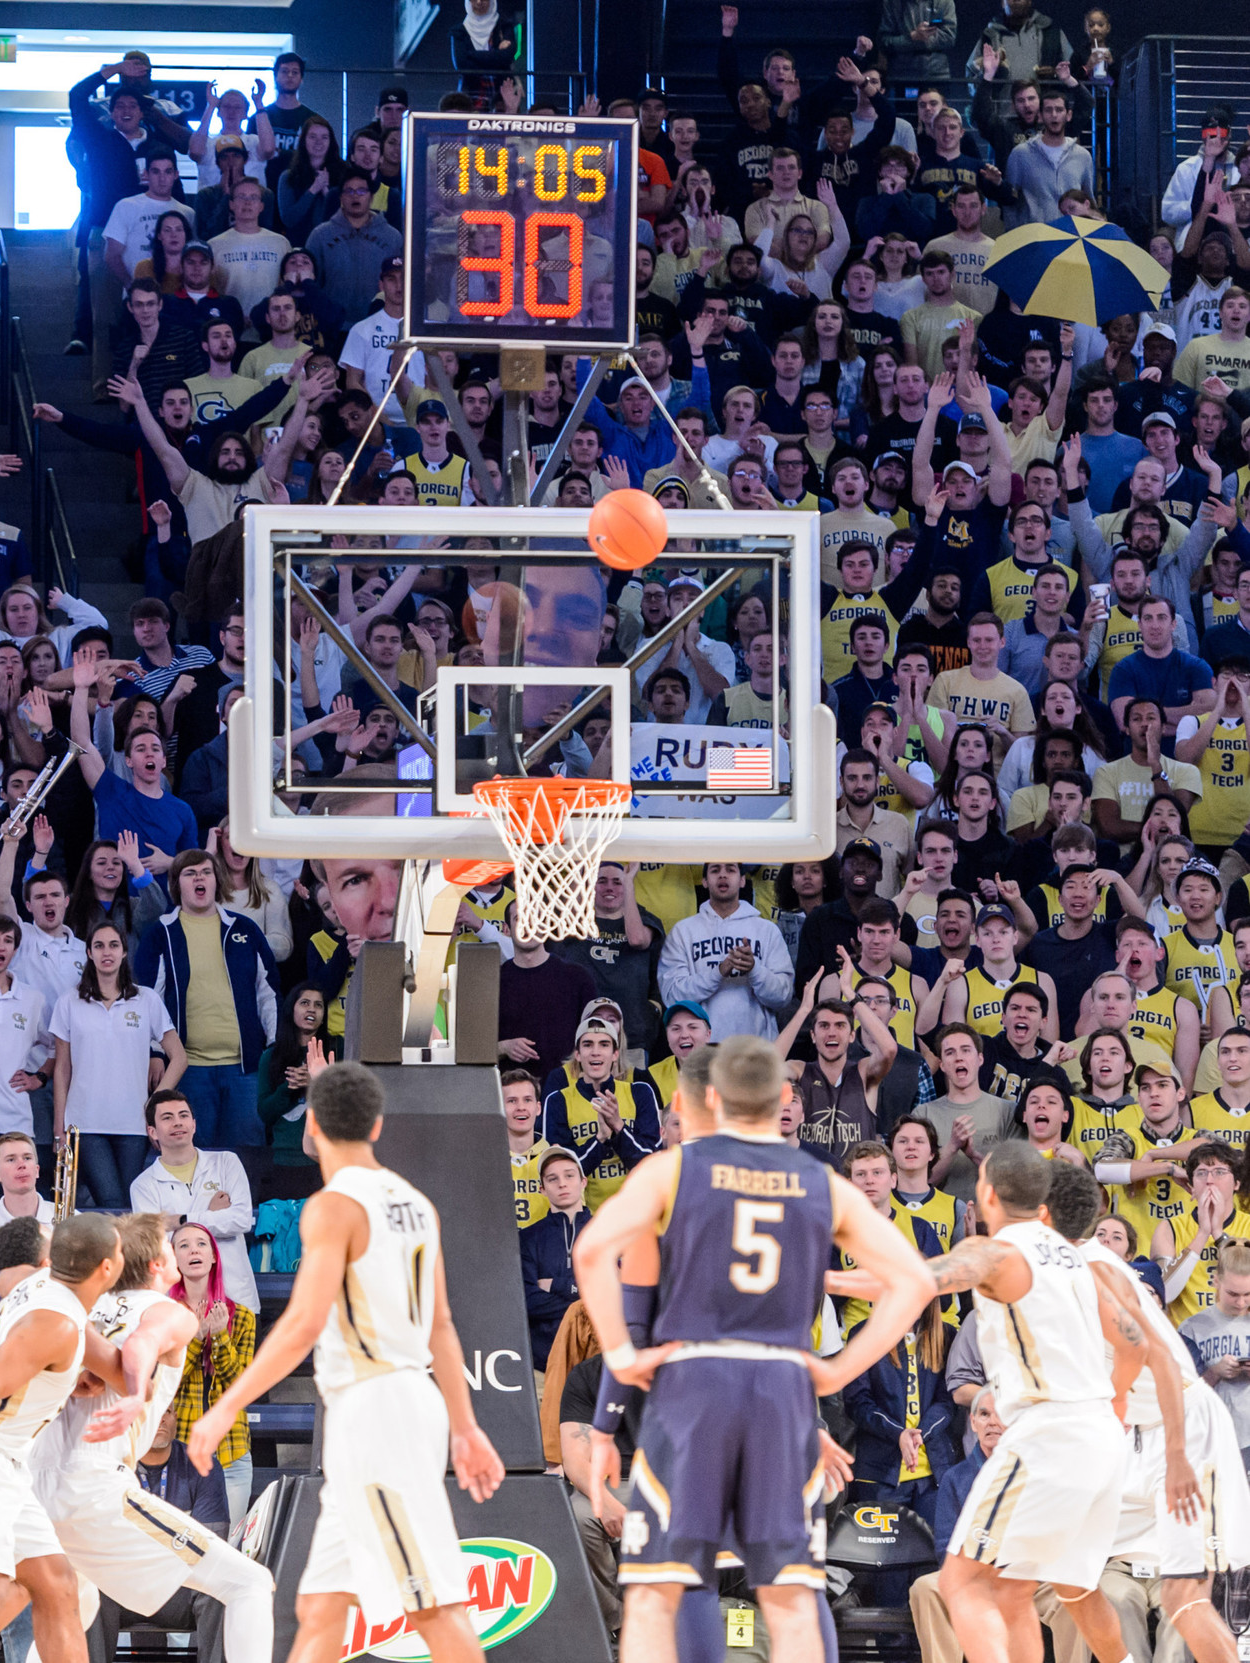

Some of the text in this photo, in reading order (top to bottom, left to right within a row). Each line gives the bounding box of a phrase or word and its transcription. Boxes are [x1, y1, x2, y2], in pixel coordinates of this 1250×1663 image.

[467, 118, 576, 134] DAKTRONICS
[458, 144, 606, 202] 14:05
[745, 163, 769, 179] TEC
[250, 249, 278, 263] JACKETS
[460, 209, 584, 319] 30
[955, 271, 989, 286] TECH
[1200, 312, 1222, 330] 43
[1205, 354, 1250, 370] SWARM
[415, 482, 458, 497] EORGIA
[822, 528, 884, 549] GEORGIA
[829, 606, 887, 622] GEORGIA
[1108, 630, 1144, 646] GEOR
[950, 696, 1011, 722] THWG
[1207, 736, 1249, 751] EORGI
[1221, 753, 1234, 771] 3
[1210, 773, 1244, 787] TECH
[639, 861, 664, 871] ECH
[230, 932, 247, 943] GT
[590, 945, 619, 964] GT
[12, 1012, 27, 1024] GT
[124, 1010, 141, 1023] GT
[800, 1121, 861, 1143] GEORGIA TECH
[592, 1163, 627, 1178] TECH
[203, 1179, 220, 1191] GT
[711, 1163, 807, 1198] FARRELL
[1156, 1179, 1170, 1201] 3
[515, 1199, 530, 1222] 3
[1148, 1200, 1184, 1219] TECH
[729, 1197, 784, 1294] 5
[1197, 1335, 1240, 1361] EORGIA
[462, 1349, 523, 1392] NC
[854, 1506, 897, 1533] GT
[857, 1535, 896, 1543] RESERVED
[971, 1527, 997, 1549] GT
[735, 1626, 744, 1638] 4
